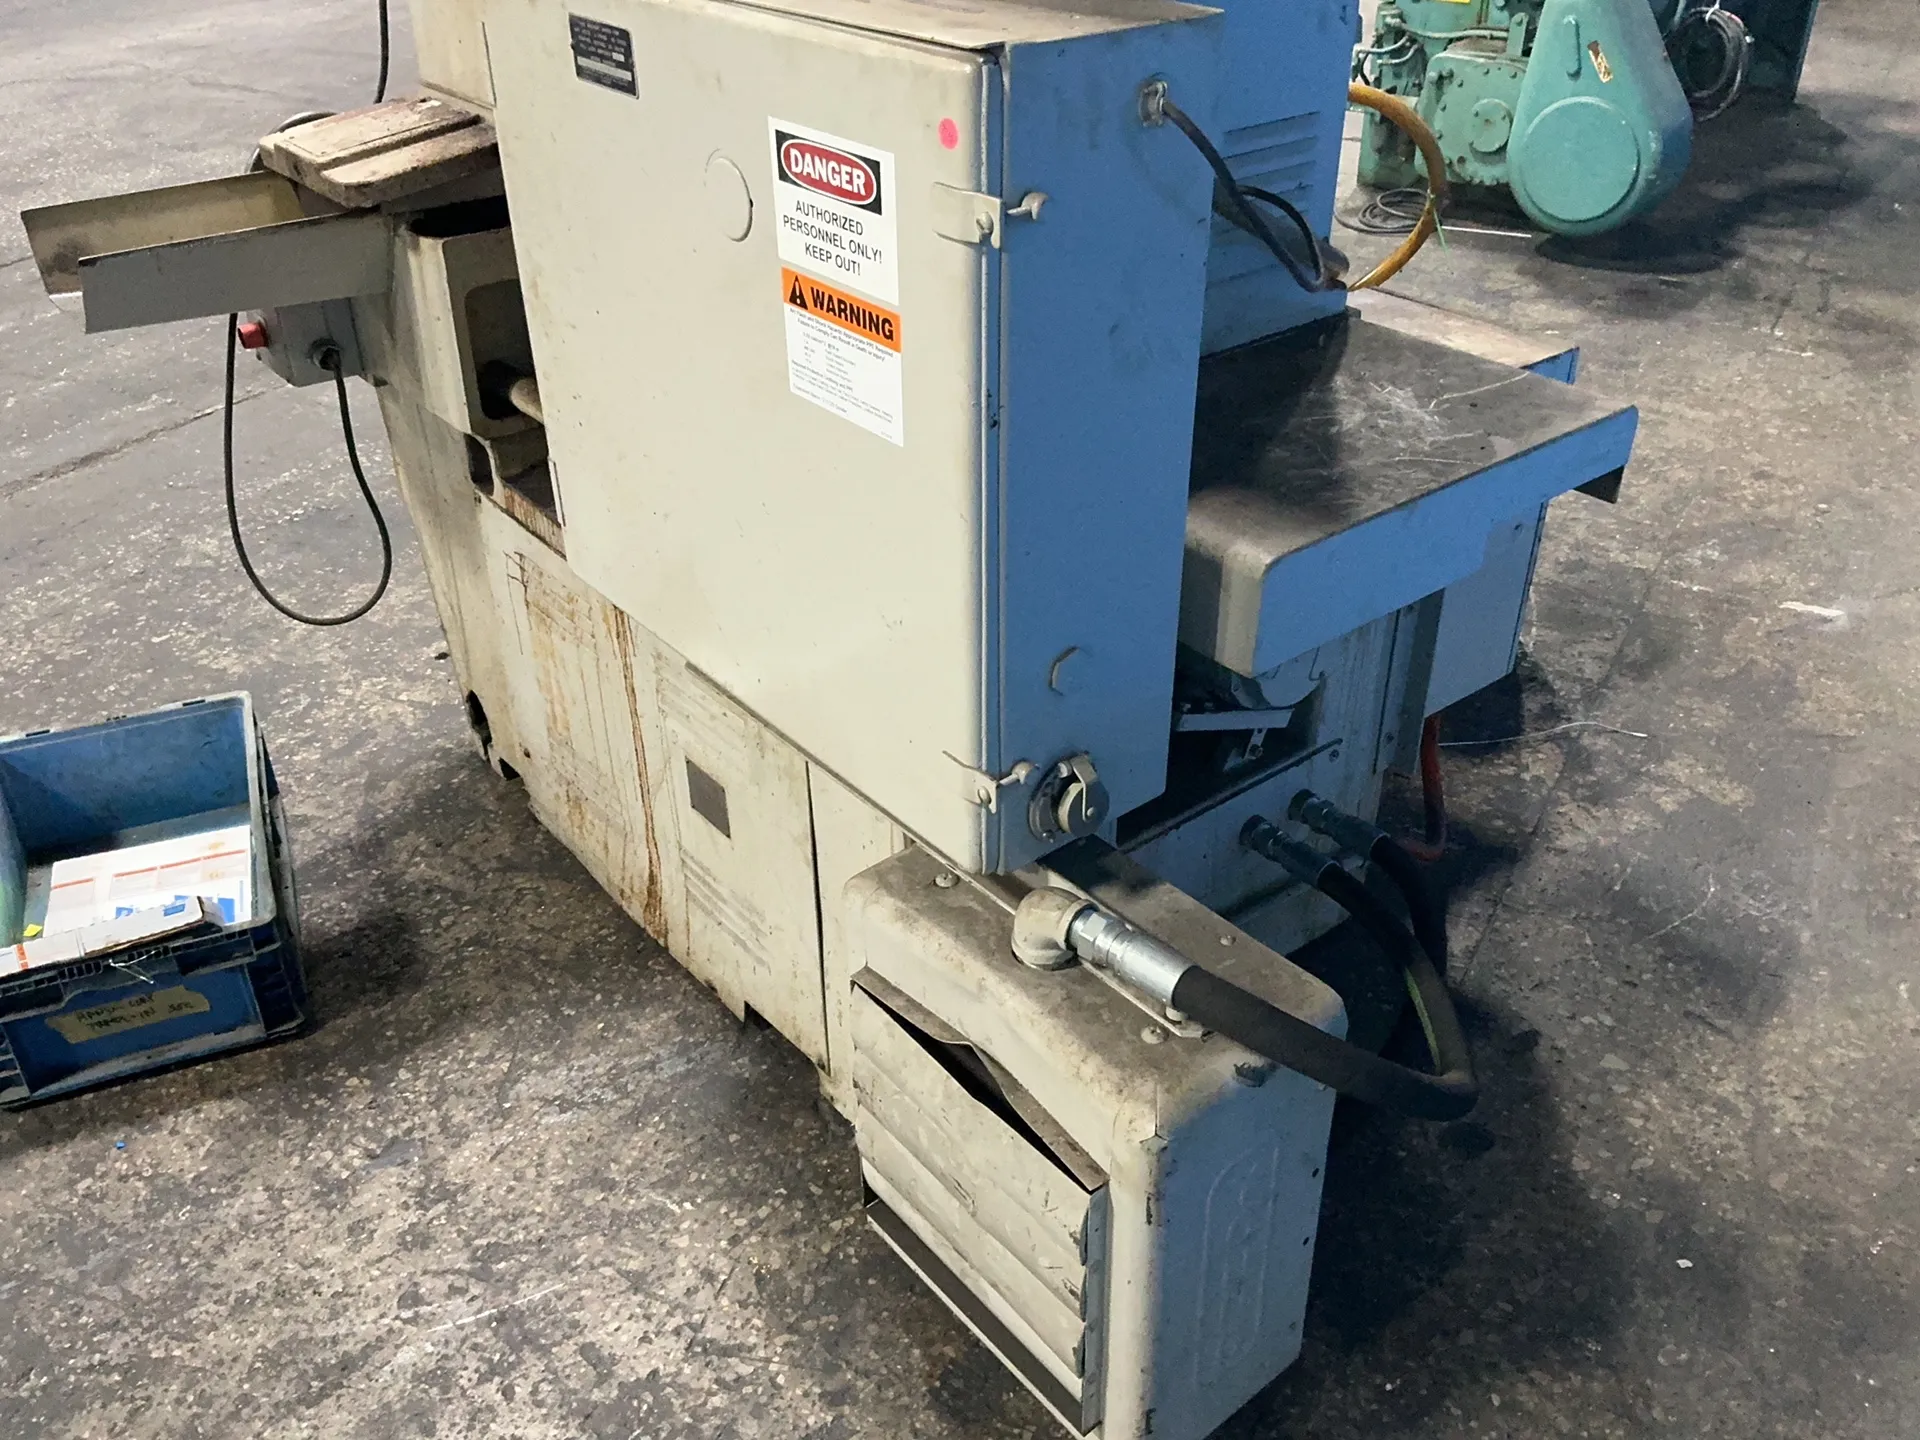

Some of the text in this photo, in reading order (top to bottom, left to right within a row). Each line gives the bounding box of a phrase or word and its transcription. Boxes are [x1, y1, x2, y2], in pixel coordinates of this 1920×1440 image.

[790, 147, 866, 196] DANGER
[783, 214, 882, 264] PERSONNEL ONLY!
[796, 200, 864, 236] AUTHORIZED
[805, 242, 861, 276] KEEP OUT!
[810, 286, 894, 342] WARNING
